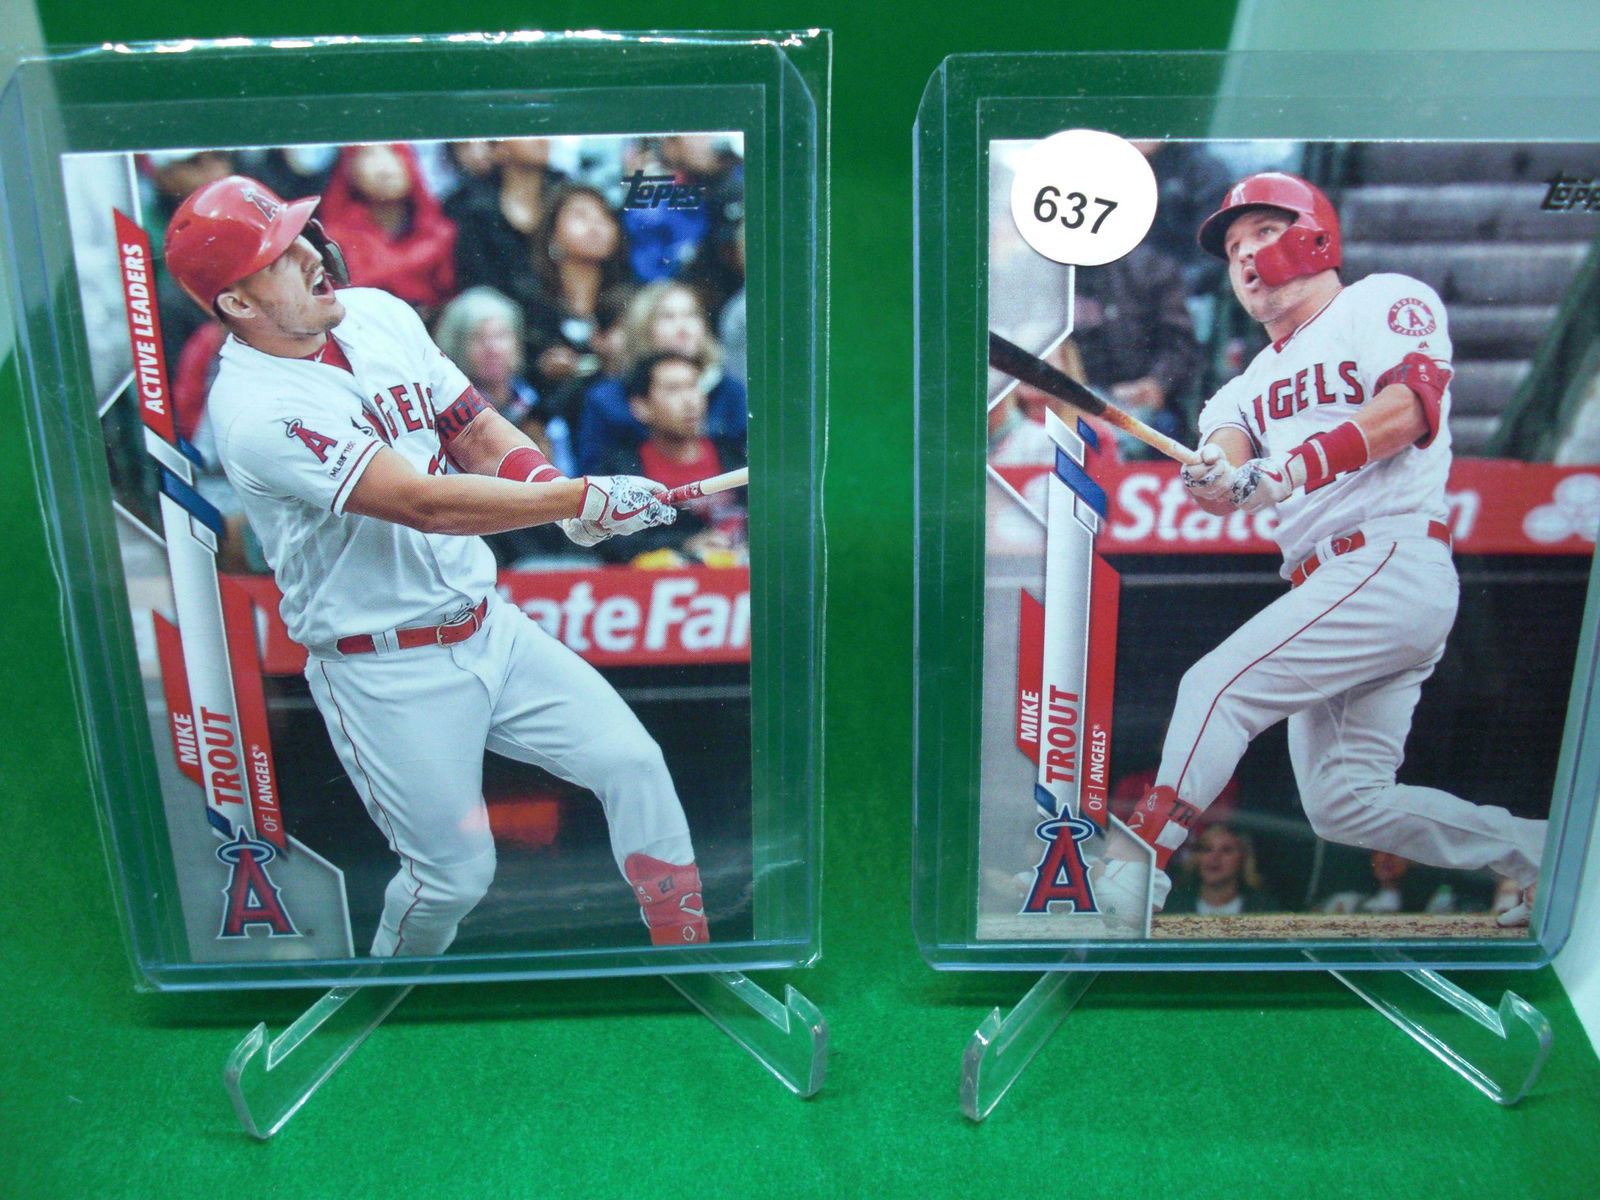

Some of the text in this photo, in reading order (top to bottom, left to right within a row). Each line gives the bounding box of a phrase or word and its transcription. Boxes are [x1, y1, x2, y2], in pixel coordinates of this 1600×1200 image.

[1033, 185, 1118, 234] 637
[123, 243, 165, 415] ACTIVE LEADERS
[173, 712, 199, 766] MIKE
[1020, 689, 1039, 743] MIKE
[1045, 684, 1079, 784] TROUT
[200, 706, 244, 806] TROUT
[262, 814, 278, 832] OF
[1088, 793, 1103, 811] OF
